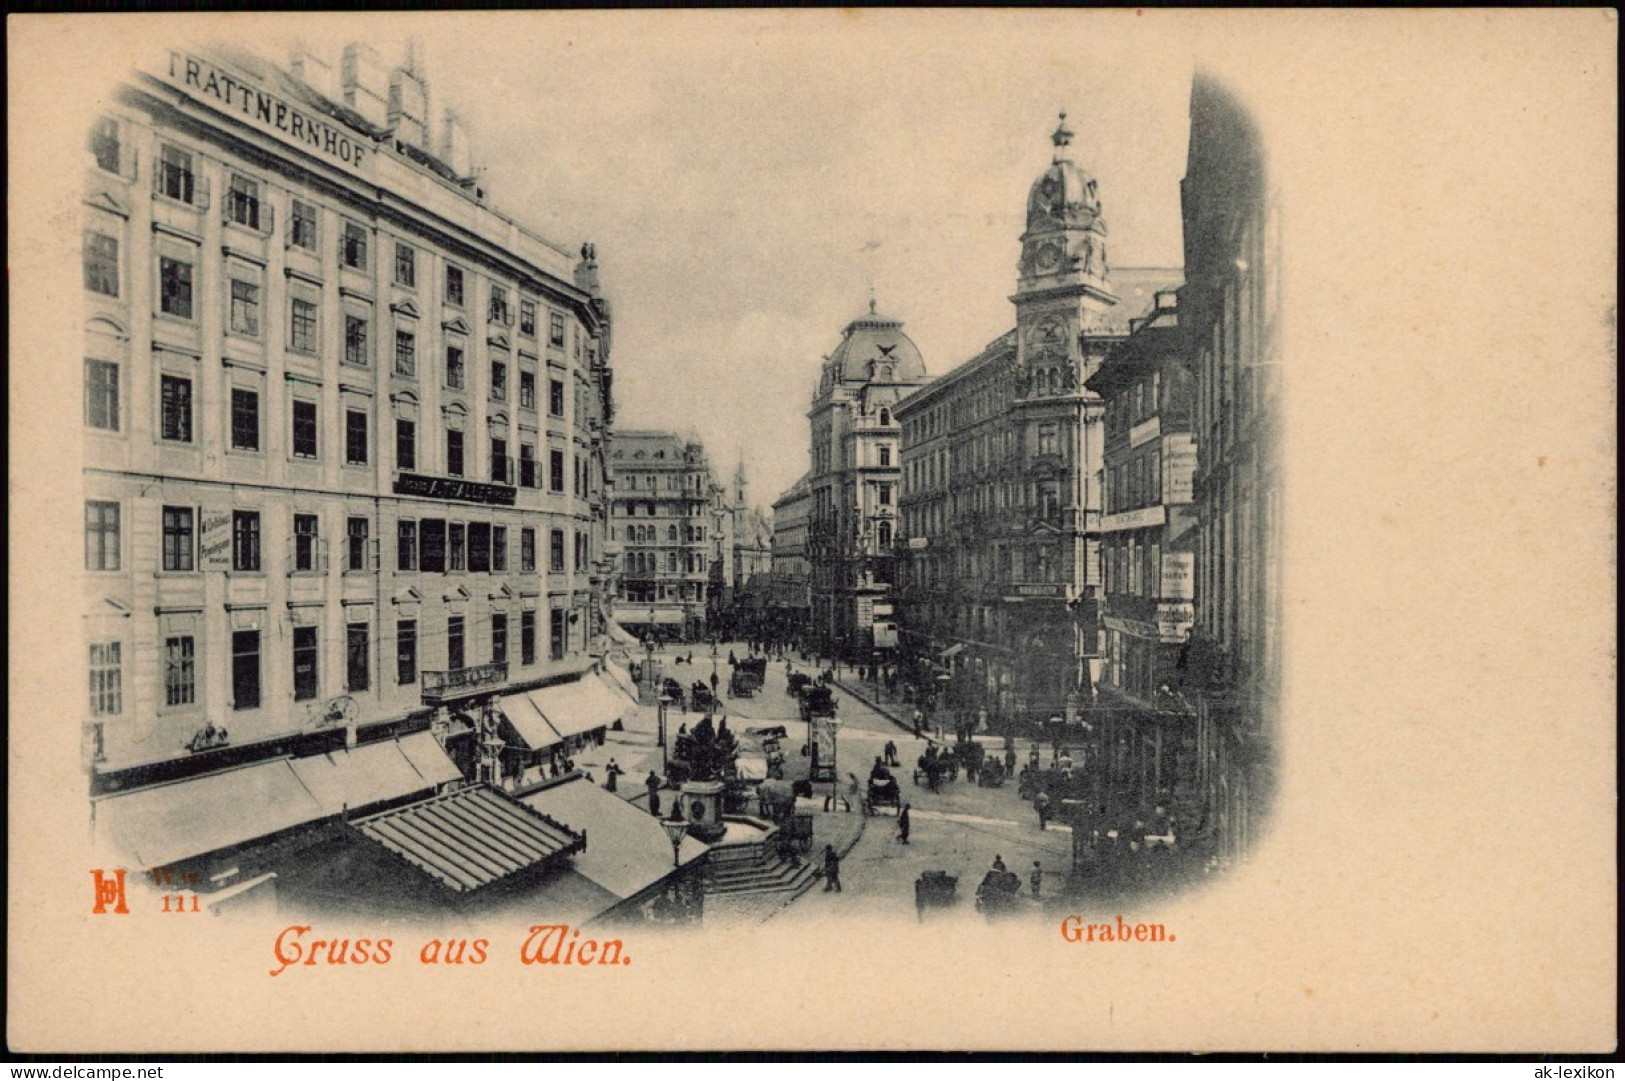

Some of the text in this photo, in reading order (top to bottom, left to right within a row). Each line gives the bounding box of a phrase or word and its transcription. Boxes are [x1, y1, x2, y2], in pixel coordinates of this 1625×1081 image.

[168, 51, 366, 167] TRATTNERNHOF
[161, 895, 201, 912] 111
[1061, 914, 1177, 944] Graben.
[269, 924, 632, 976] Gruss aus Wien.
